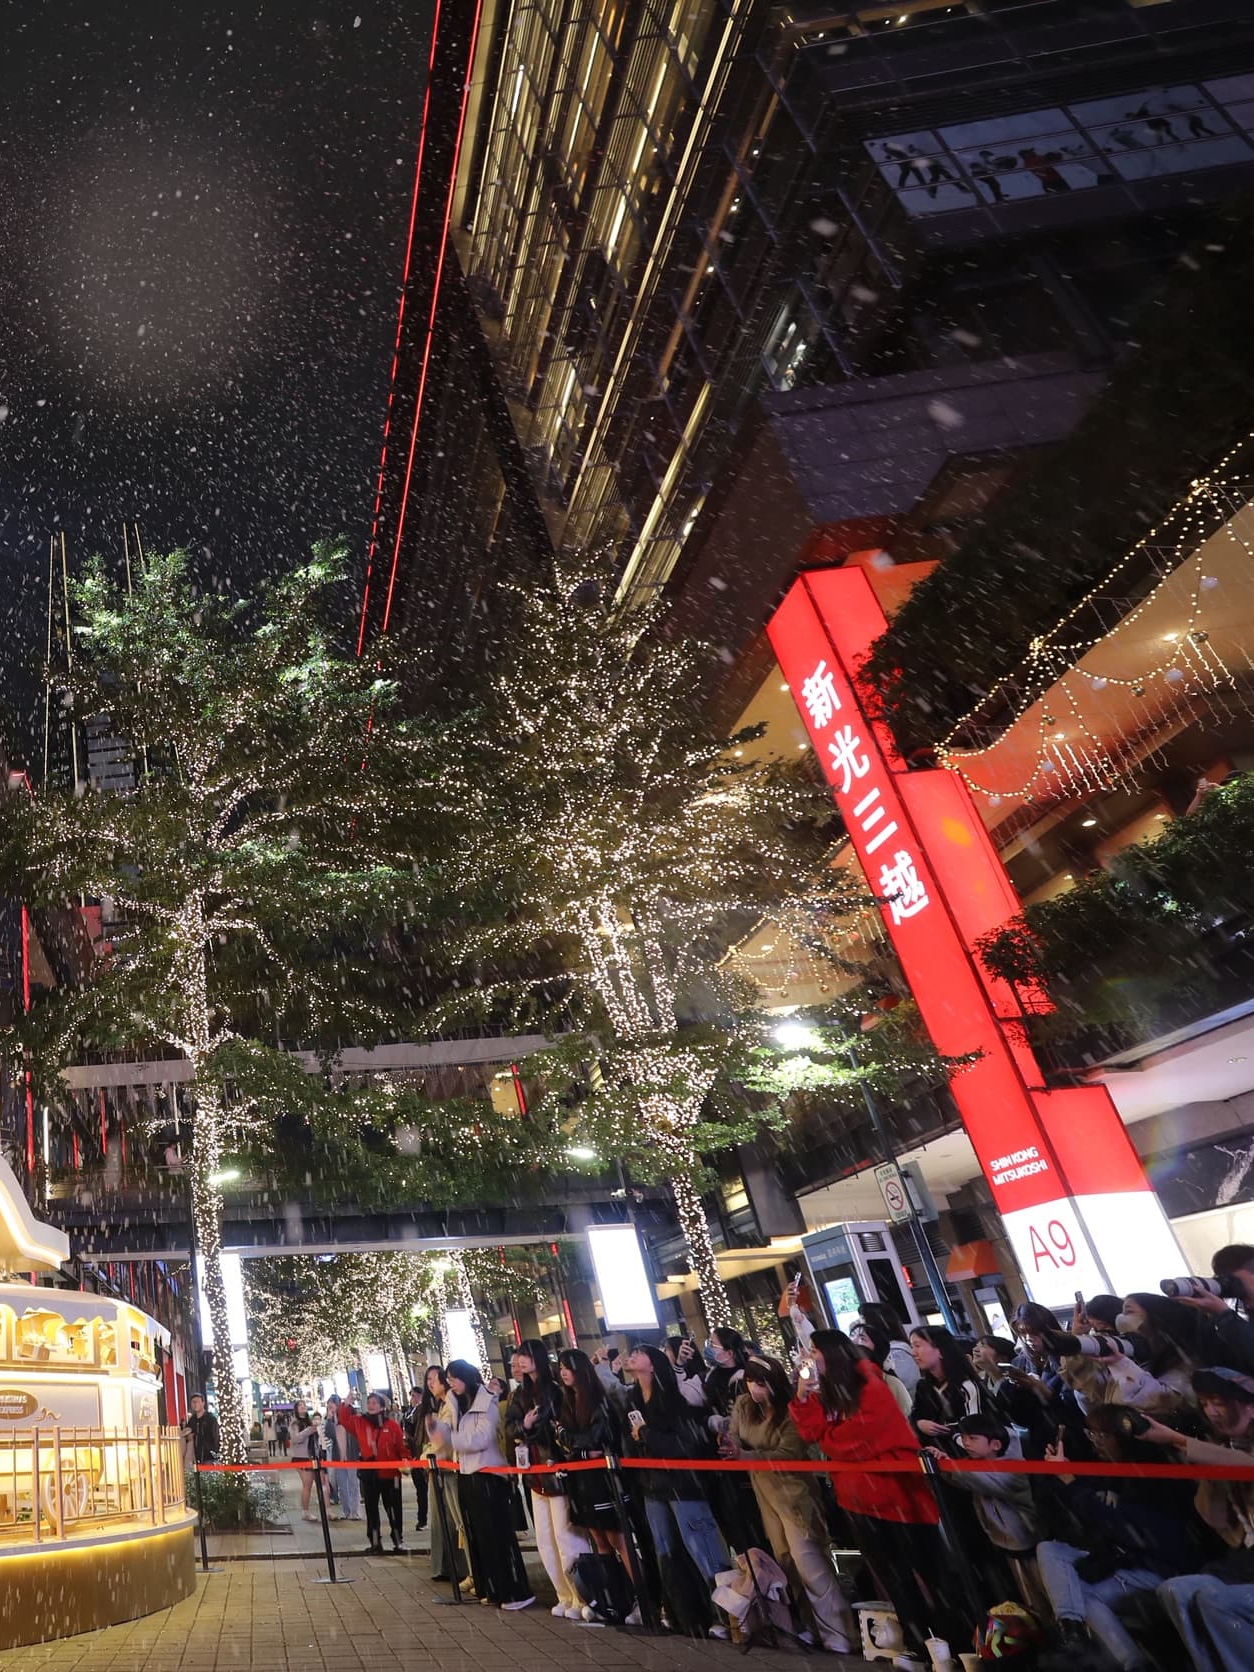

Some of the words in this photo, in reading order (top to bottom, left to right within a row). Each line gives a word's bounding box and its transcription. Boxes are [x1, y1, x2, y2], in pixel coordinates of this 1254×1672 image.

[801, 660, 930, 925] 新光三越
[990, 1154, 1013, 1171] SHIN
[1010, 1146, 1039, 1164] KONG
[992, 1159, 1049, 1186] MITSUKOSHI
[1028, 1219, 1077, 1274] A9
